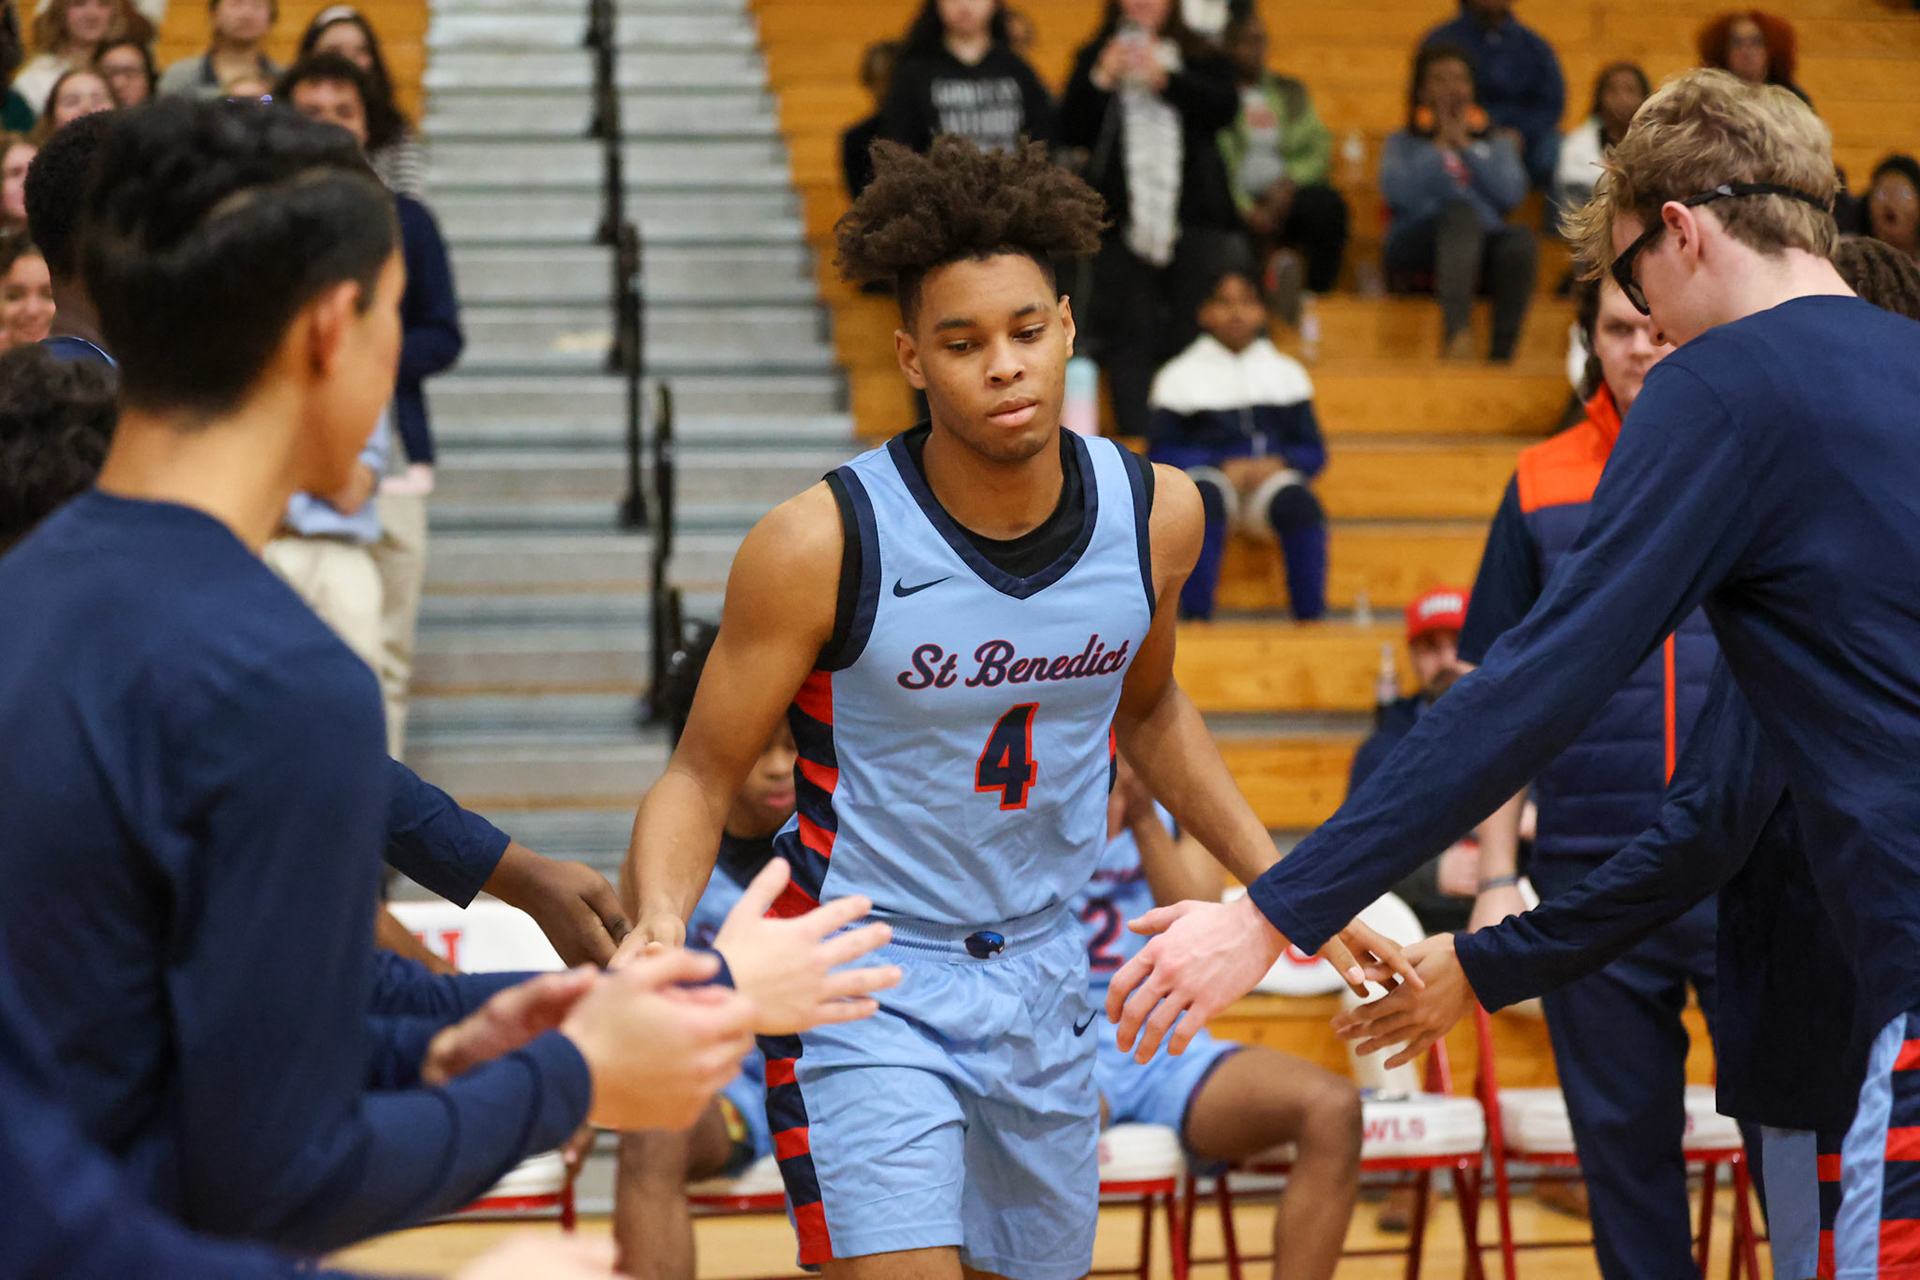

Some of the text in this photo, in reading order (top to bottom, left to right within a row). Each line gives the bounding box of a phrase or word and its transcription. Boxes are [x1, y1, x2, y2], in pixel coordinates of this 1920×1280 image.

[897, 634, 1130, 690] St Benedict
[974, 702, 1040, 811] 4
